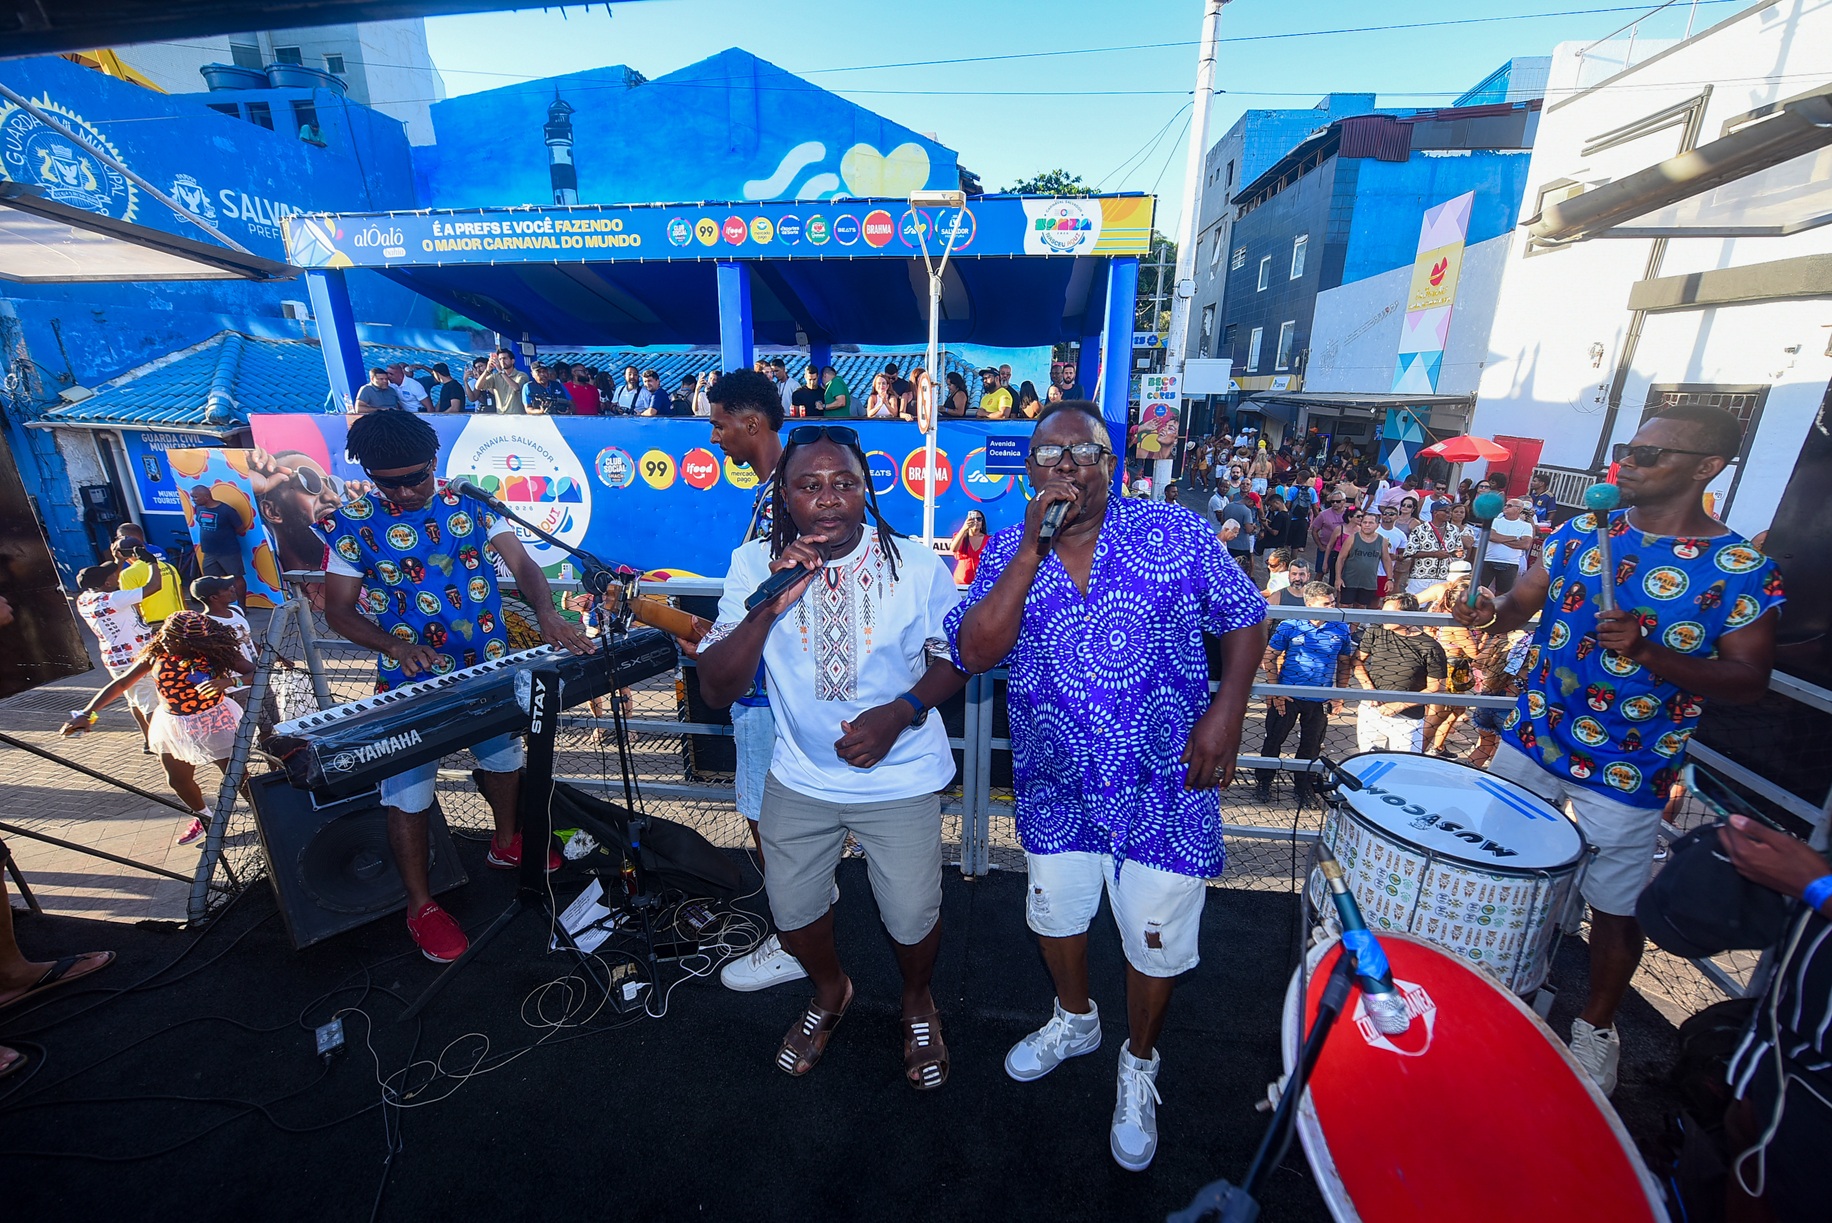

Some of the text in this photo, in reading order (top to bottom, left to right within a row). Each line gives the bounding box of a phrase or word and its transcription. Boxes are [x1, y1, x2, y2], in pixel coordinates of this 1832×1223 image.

[6, 113, 44, 166] GUARDA
[432, 217, 623, 236] É A PREFS E VOCÊ FAZENDO
[699, 226, 714, 237] 99
[866, 224, 892, 235] BRAHMA
[422, 233, 642, 252] O MAIOR CARNAVAL DO MUNDO
[1046, 233, 1065, 247] NASCEU
[1148, 376, 1177, 386] BECO
[141, 433, 203, 444] GUARDA CIVIL
[472, 435, 555, 463] CARNAVAL SALVADOR
[605, 457, 622, 465] CLUB
[646, 461, 668, 476] 99
[687, 463, 713, 474] ifood
[908, 467, 948, 481] BRAMA
[538, 507, 561, 533] QUI
[1355, 549, 1380, 558] favela
[531, 678, 546, 734] STAY
[354, 729, 422, 764] YAMAHA
